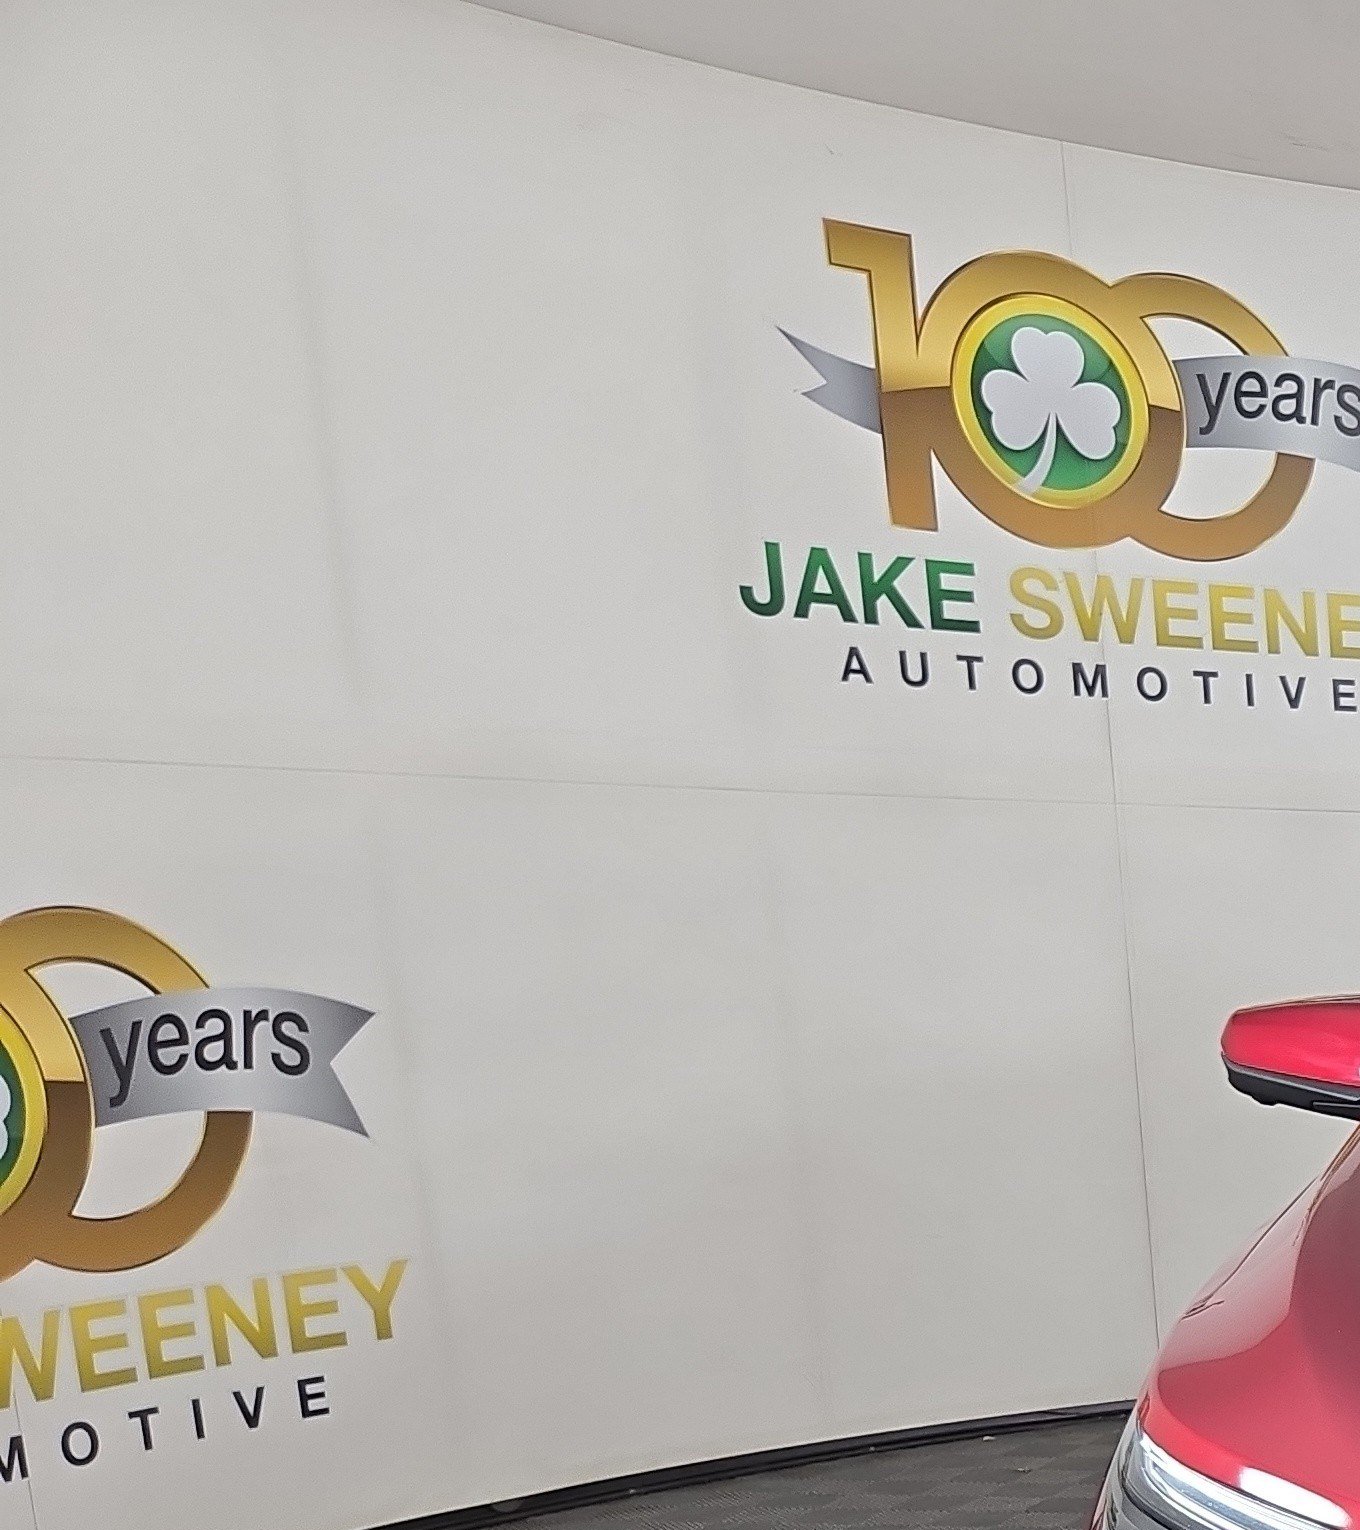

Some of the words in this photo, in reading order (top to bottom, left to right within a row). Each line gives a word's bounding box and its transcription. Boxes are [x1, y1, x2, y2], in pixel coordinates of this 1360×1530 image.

[822, 218, 1316, 562] 100
[739, 541, 980, 633] JAKE
[841, 646, 1357, 712] AUTOMOTIVE
[99, 1008, 311, 1108] years
